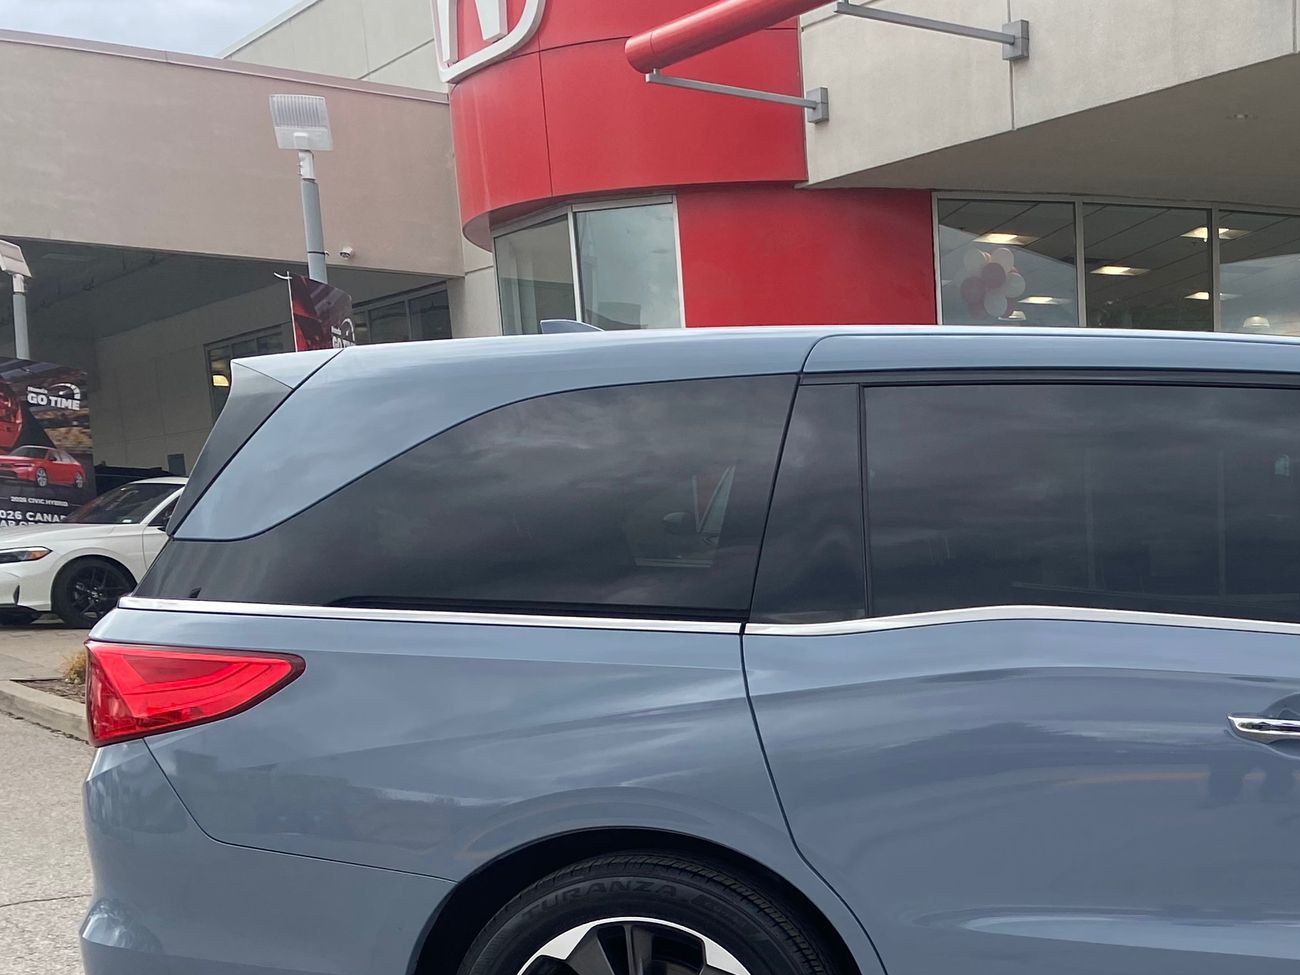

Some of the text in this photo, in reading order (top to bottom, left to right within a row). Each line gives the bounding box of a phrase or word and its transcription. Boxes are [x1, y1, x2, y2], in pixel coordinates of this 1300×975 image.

[27, 393, 81, 411] GO TIME
[521, 880, 678, 918] TURANZA
